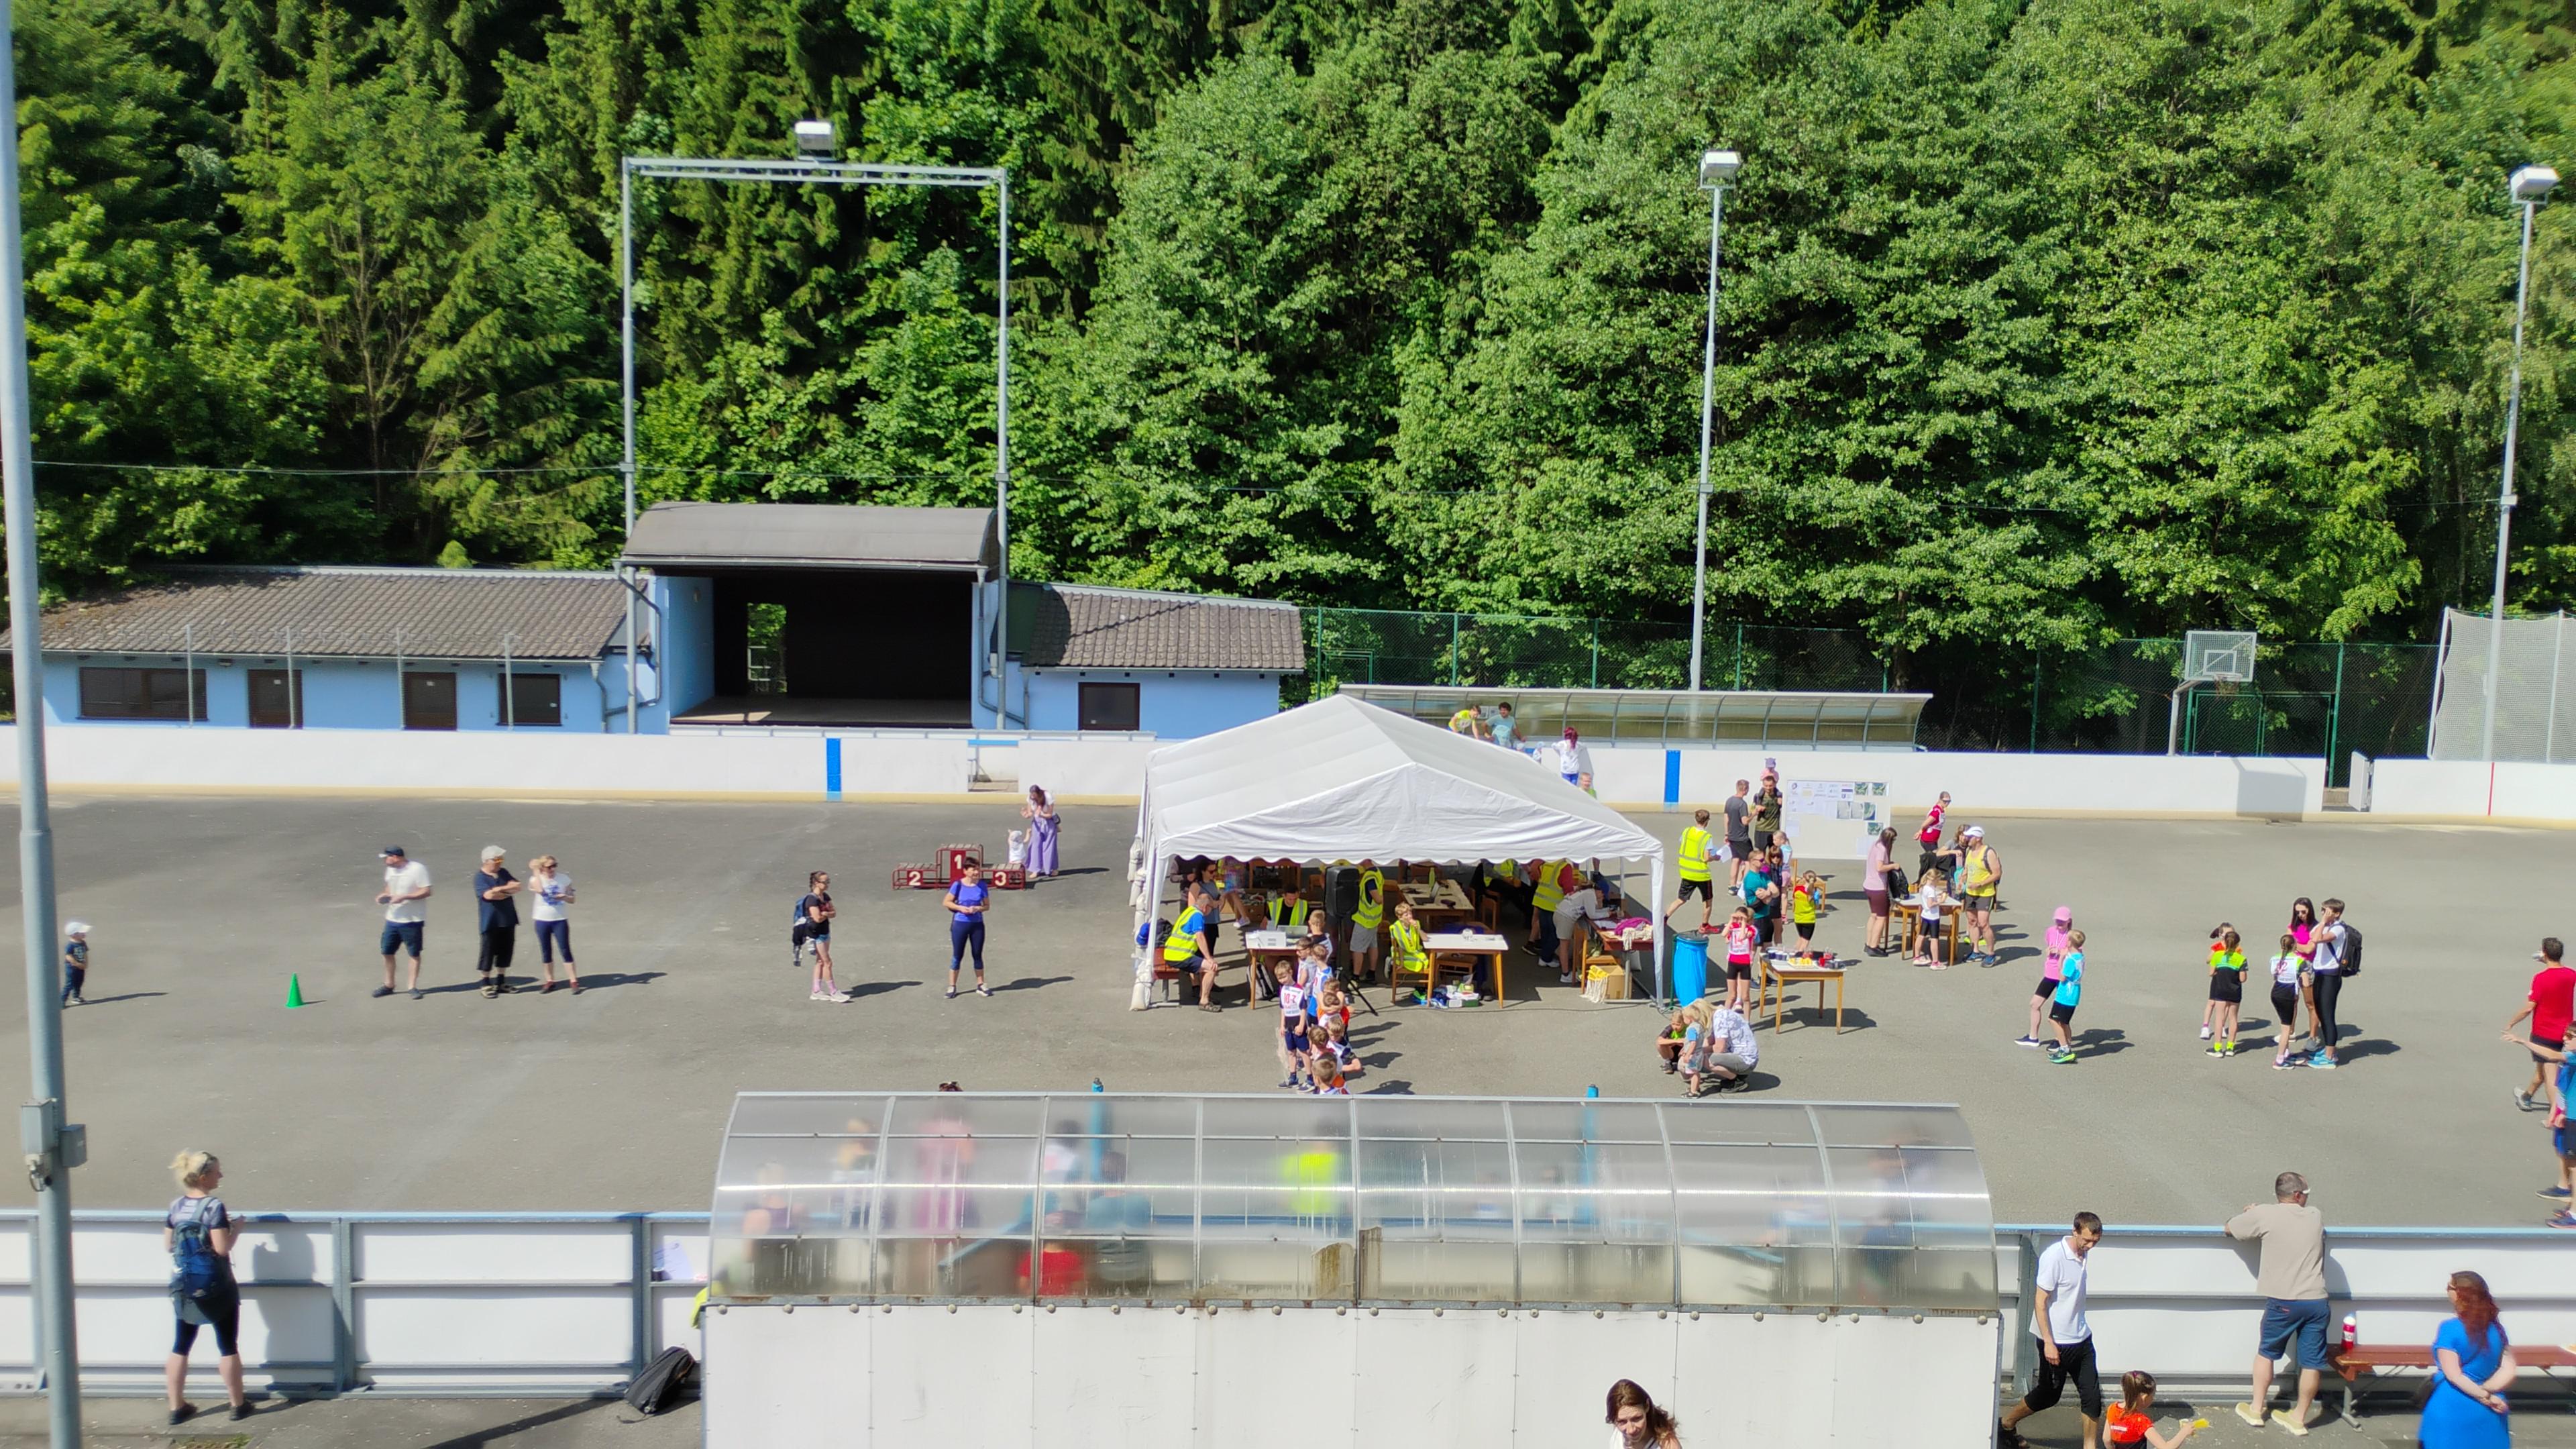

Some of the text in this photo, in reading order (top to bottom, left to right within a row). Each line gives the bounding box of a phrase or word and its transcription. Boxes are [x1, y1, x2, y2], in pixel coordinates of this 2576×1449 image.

[954, 854, 962, 869] 1
[908, 871, 921, 886] 2
[994, 871, 1006, 886] 3
